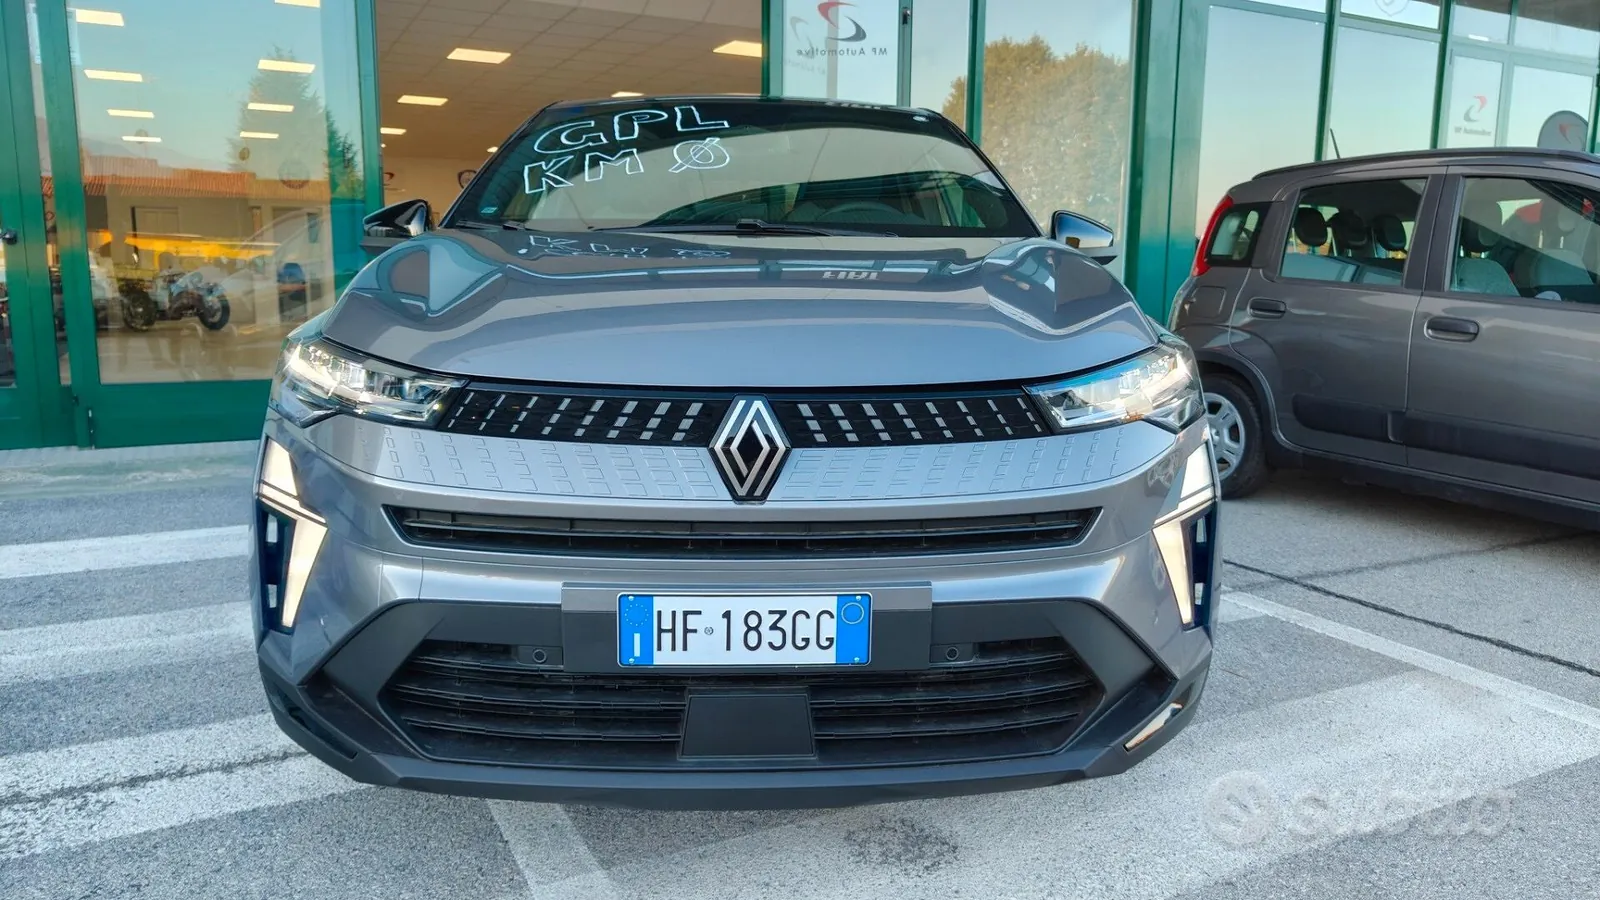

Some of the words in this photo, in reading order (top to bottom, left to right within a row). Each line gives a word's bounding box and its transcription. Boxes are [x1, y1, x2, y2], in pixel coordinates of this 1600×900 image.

[534, 105, 730, 153] GPL
[523, 148, 645, 194] KM
[656, 610, 702, 651] HF
[721, 609, 835, 651] 183GG
